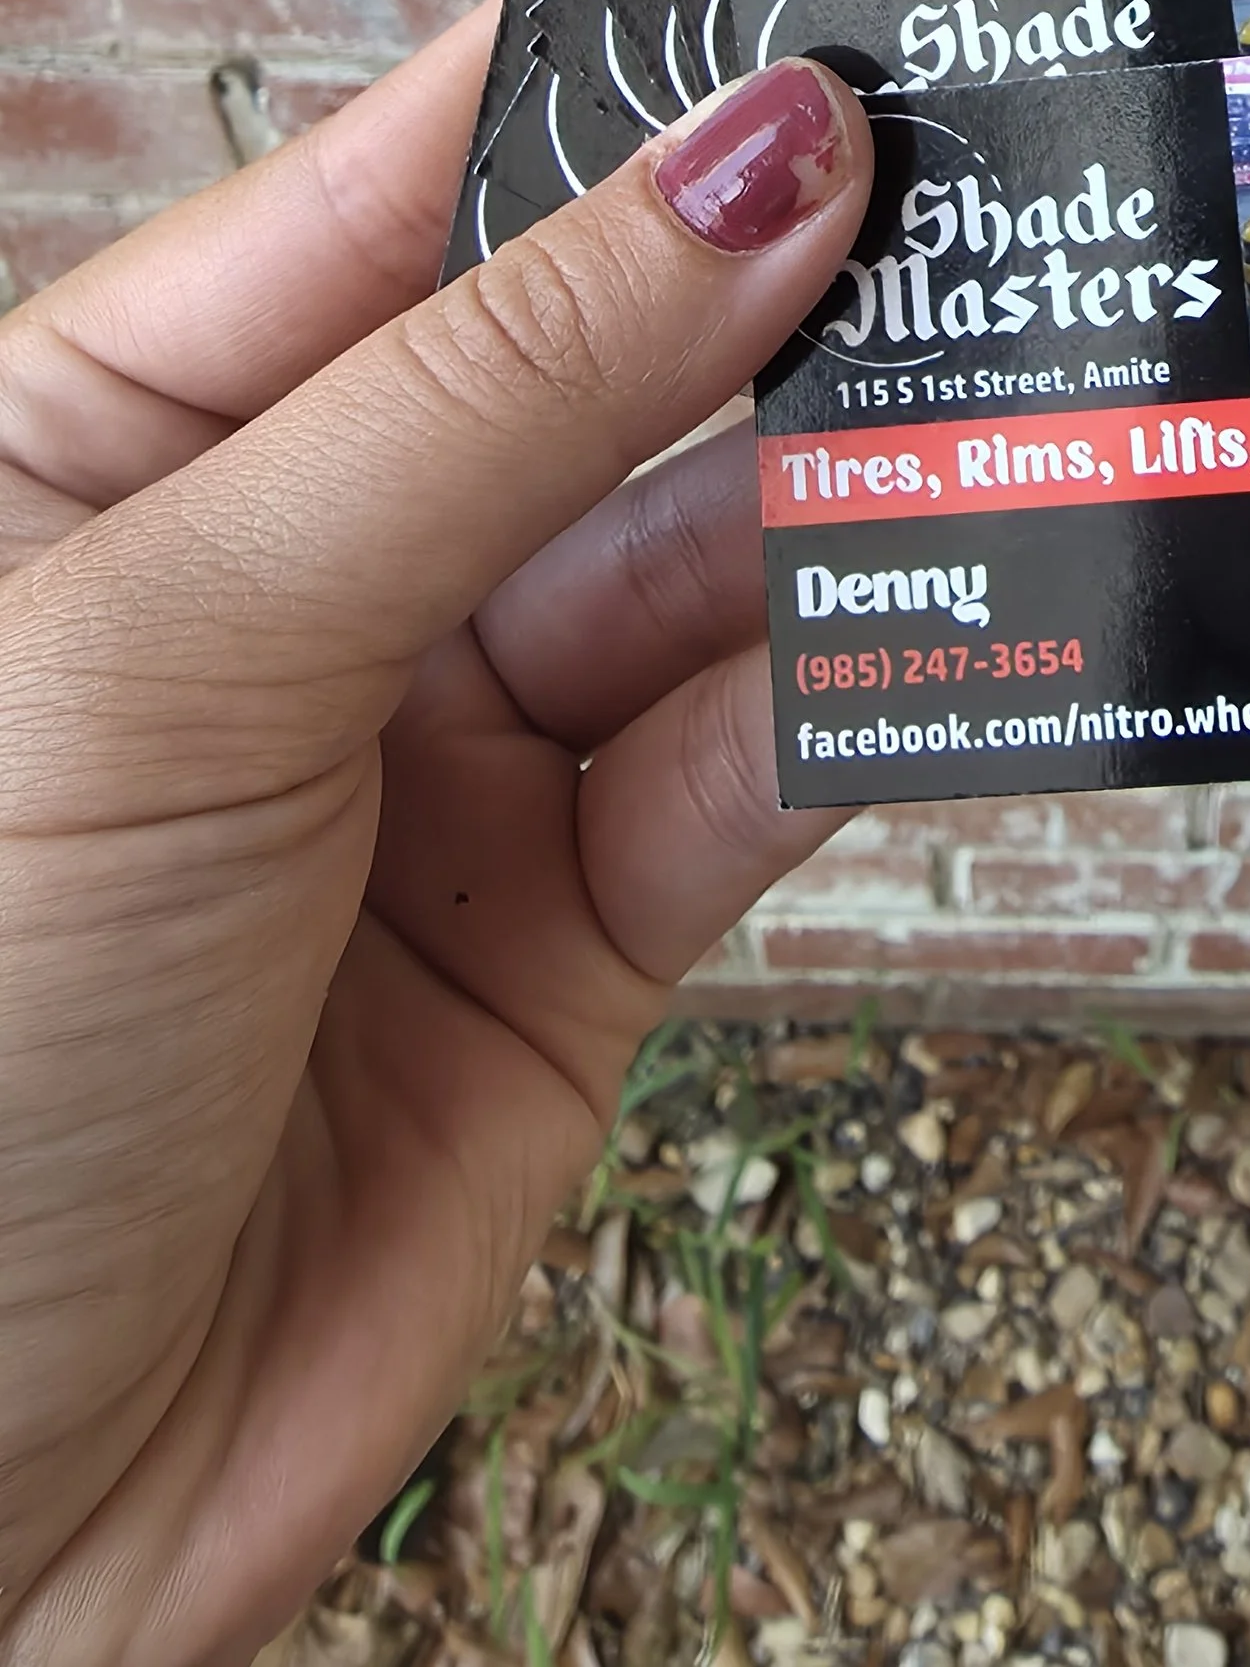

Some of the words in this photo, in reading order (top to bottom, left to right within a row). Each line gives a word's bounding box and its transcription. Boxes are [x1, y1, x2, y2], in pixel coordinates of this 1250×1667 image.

[901, 162, 1158, 268] Shade
[823, 248, 1222, 347] Masters
[837, 379, 890, 409] 115
[897, 376, 914, 404] S
[921, 371, 968, 402] 1st
[973, 366, 1077, 398] Street,
[1083, 358, 1170, 389] Amite
[781, 447, 943, 501] Tires,
[957, 432, 1116, 489] Rims,
[796, 563, 991, 628] Denny
[796, 649, 893, 695] (985)
[903, 638, 1085, 685] 247-3654
